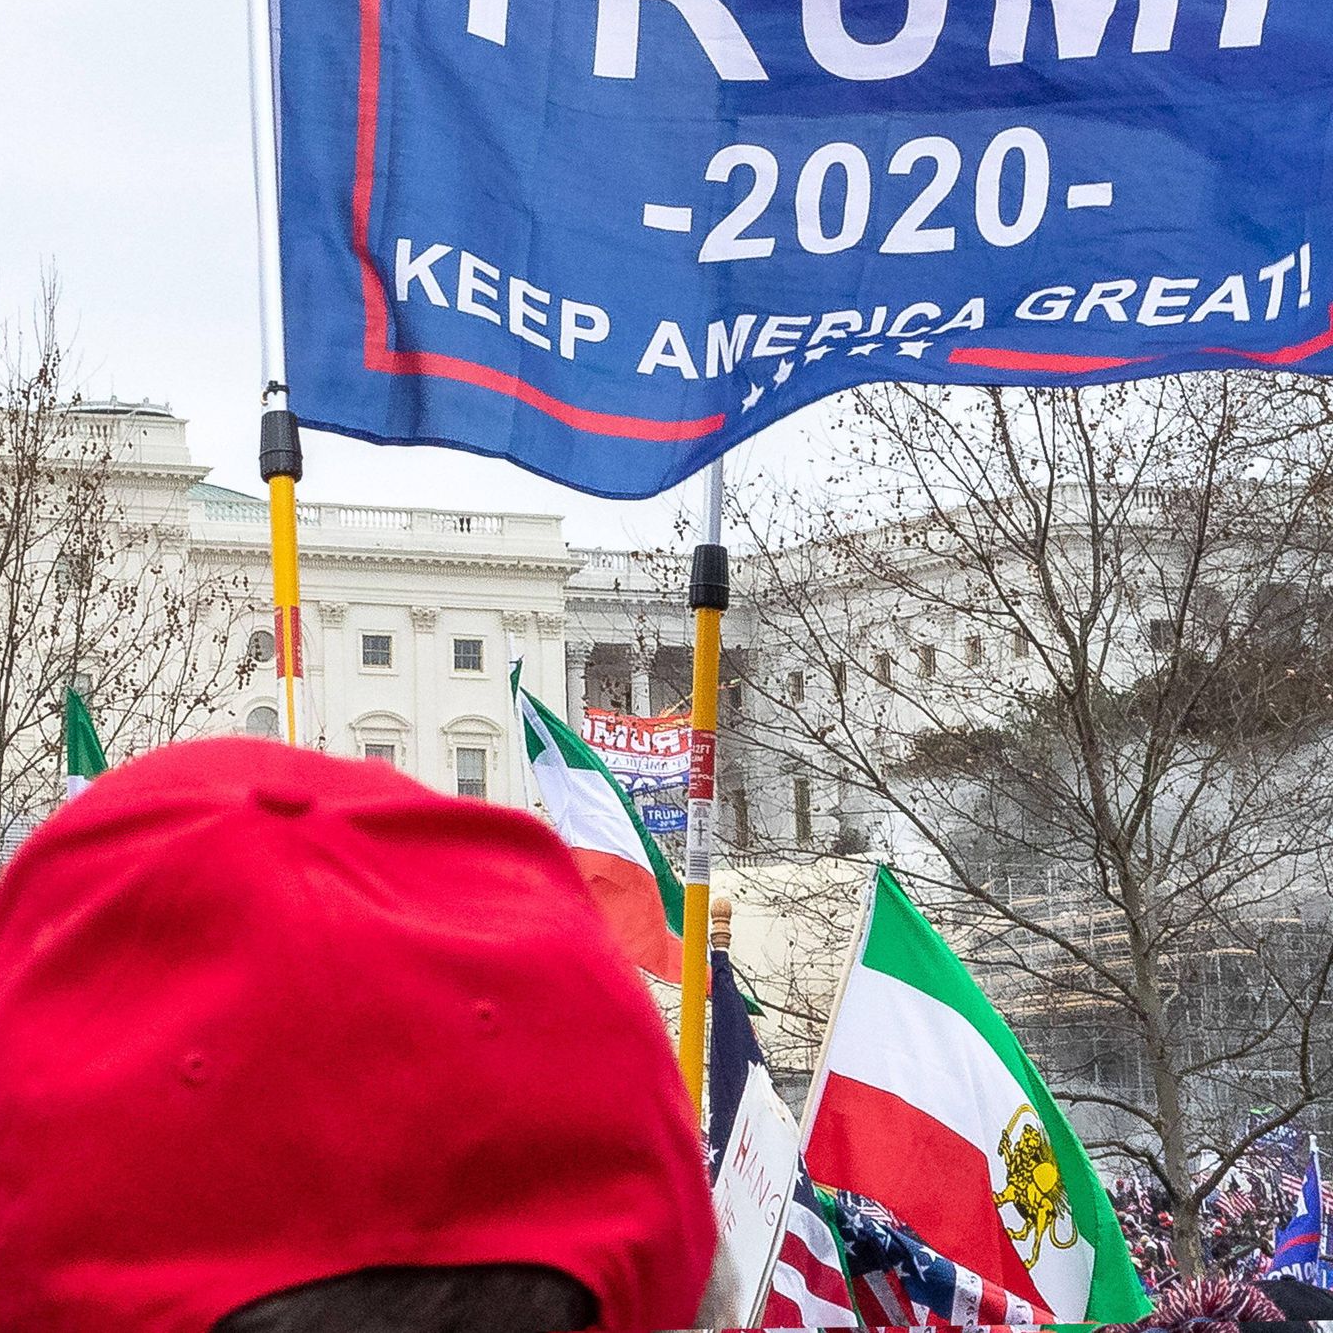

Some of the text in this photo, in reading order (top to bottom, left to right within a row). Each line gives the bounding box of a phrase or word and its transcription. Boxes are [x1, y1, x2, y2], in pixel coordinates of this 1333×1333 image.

[643, 125, 1114, 265] -2020-
[395, 237, 1313, 380] KEEP AMERICA GREAT!
[733, 1115, 783, 1228] HANG
